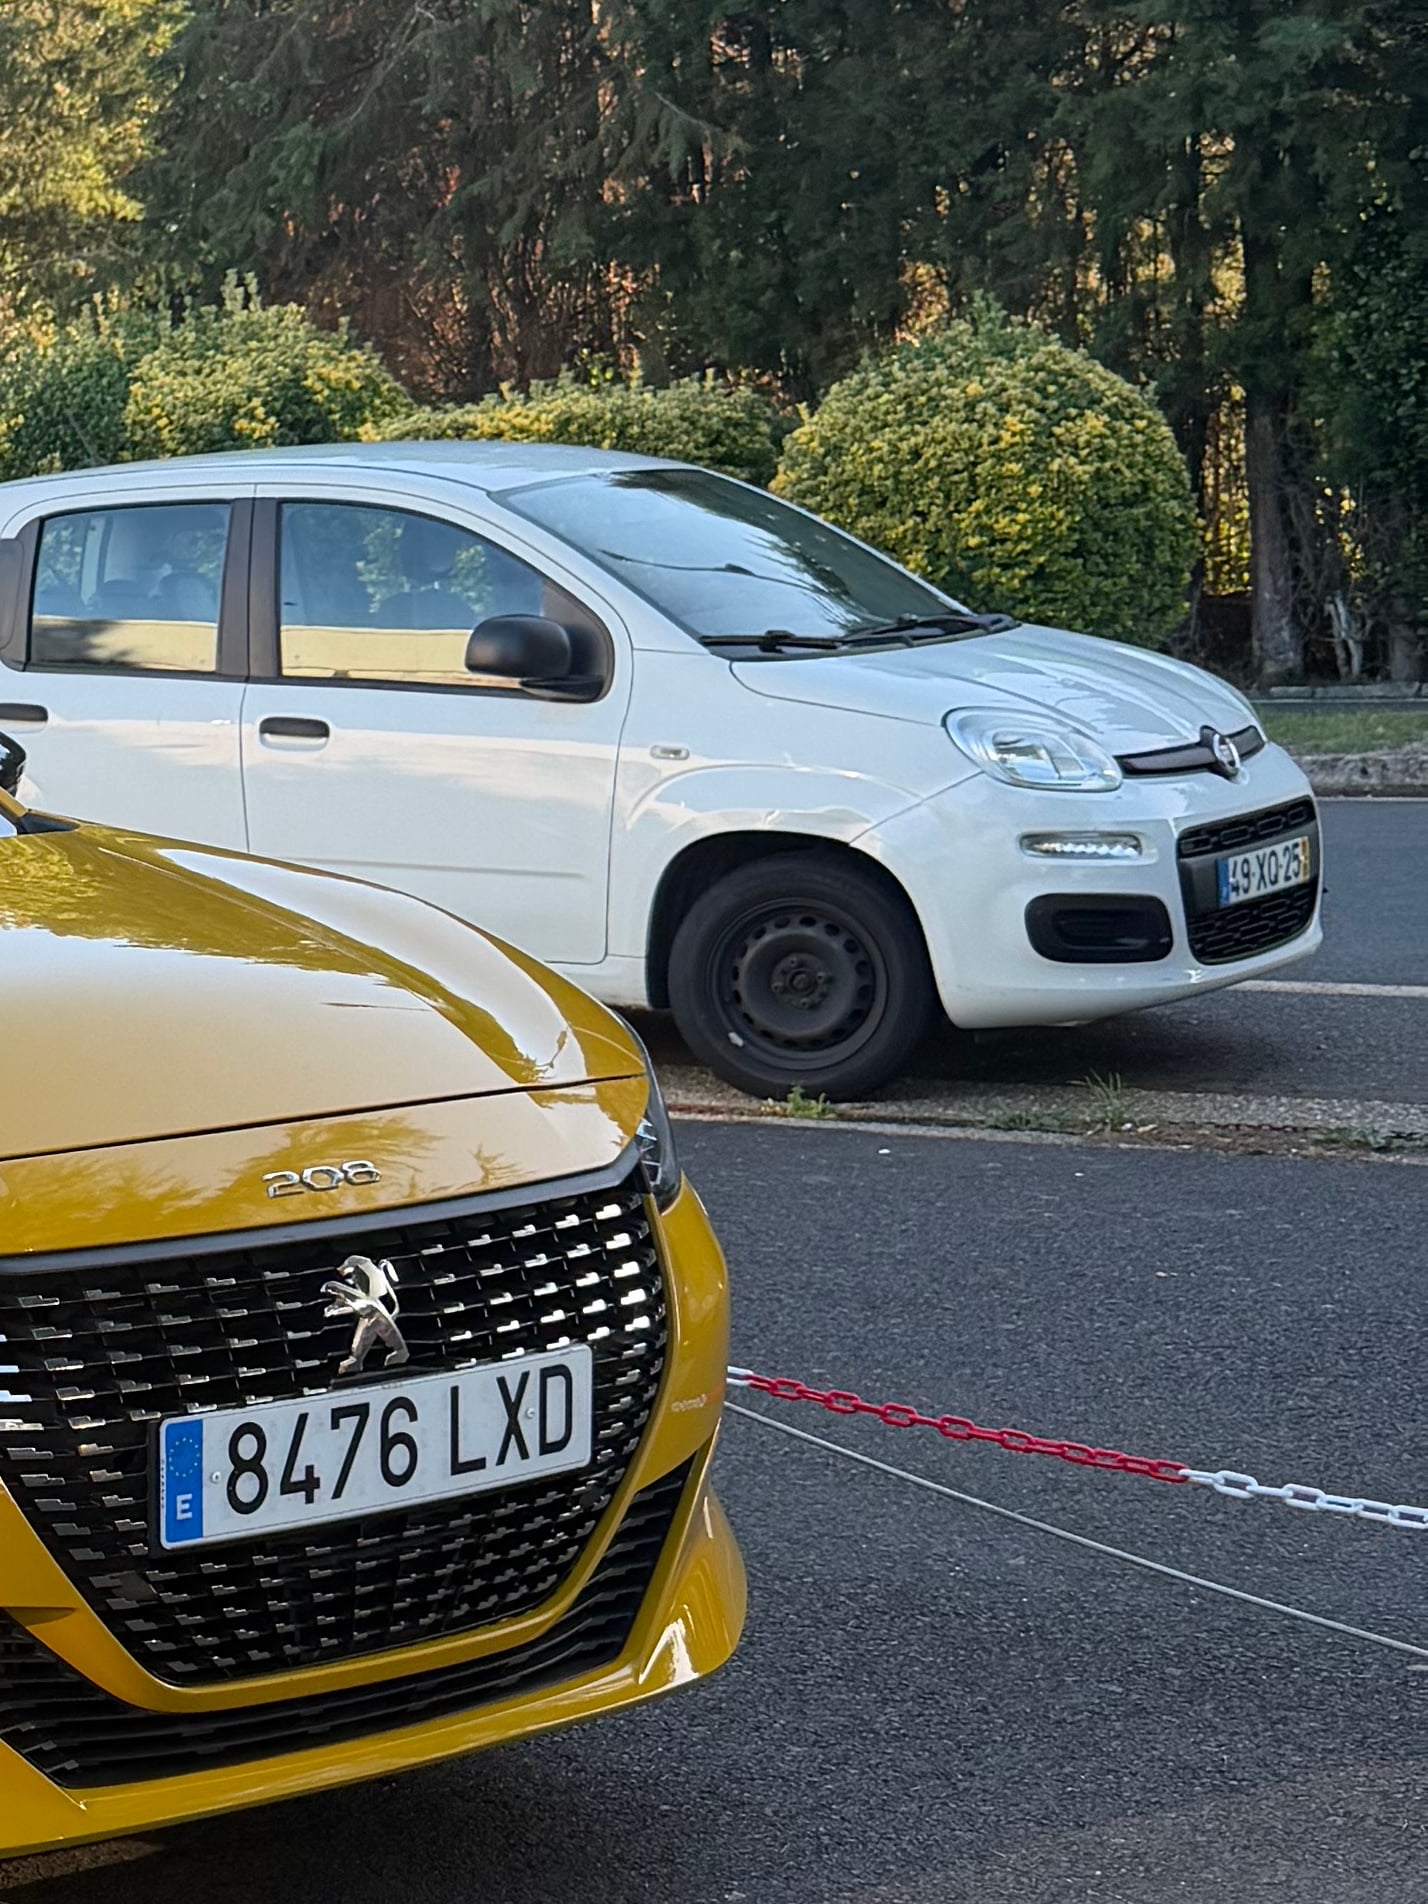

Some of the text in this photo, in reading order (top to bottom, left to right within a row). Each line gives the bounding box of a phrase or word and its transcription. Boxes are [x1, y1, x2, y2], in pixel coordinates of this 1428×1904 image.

[262, 1159, 382, 1198] 208
[225, 1396, 418, 1515] 8476
[449, 1363, 574, 1476] LXD
[175, 1493, 193, 1521] E
